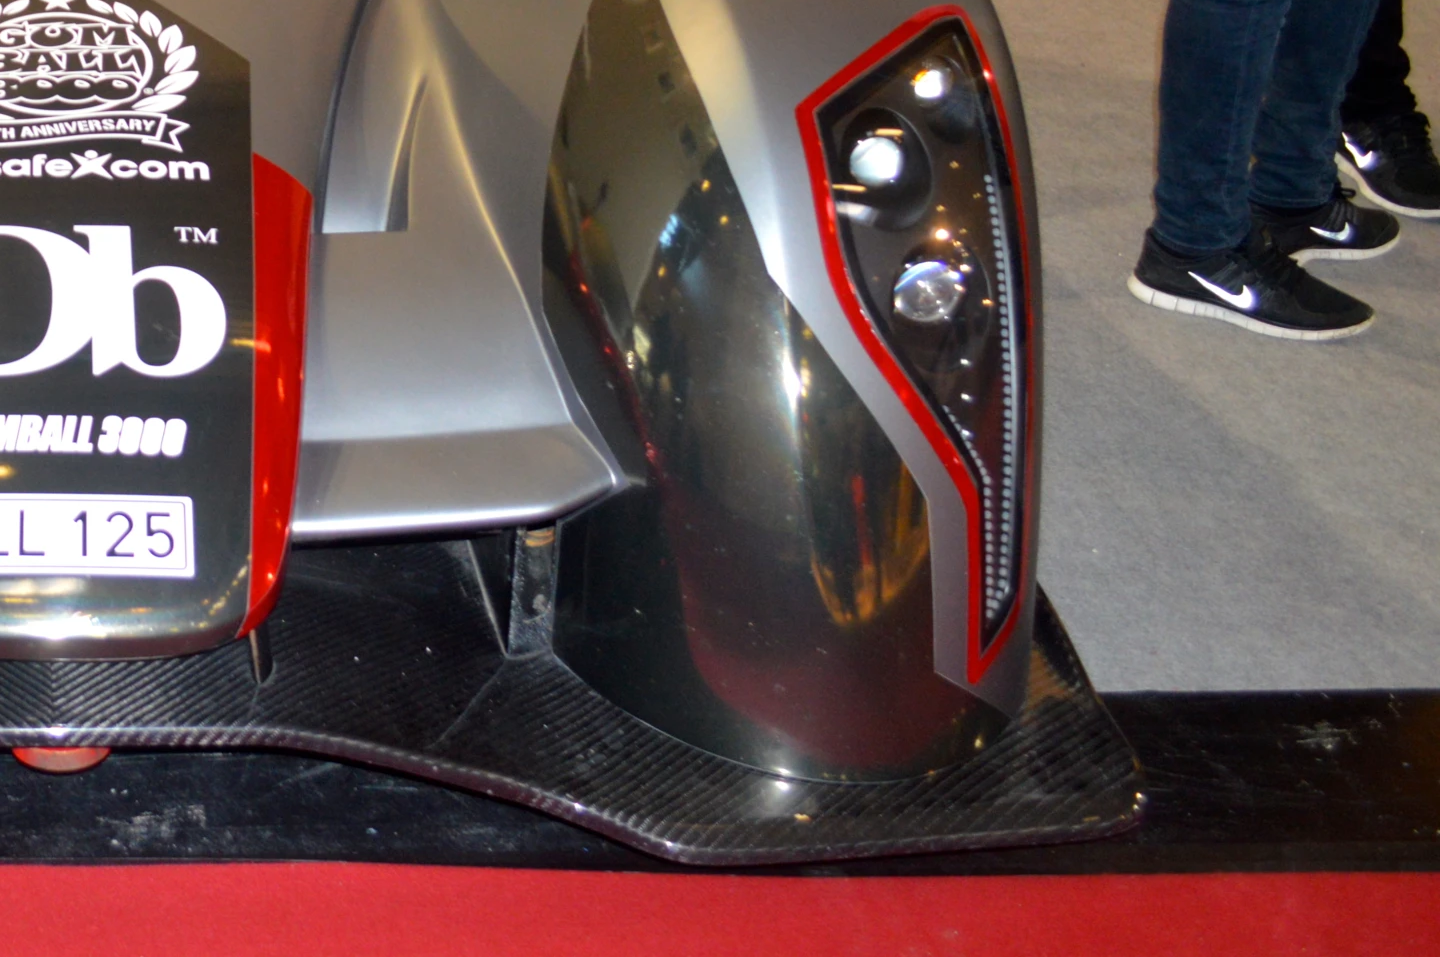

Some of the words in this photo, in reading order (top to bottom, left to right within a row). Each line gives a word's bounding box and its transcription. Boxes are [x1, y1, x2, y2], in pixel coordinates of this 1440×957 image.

[20, 117, 157, 140] ANNIVERSARY
[98, 414, 188, 458] 3000
[73, 509, 175, 558] 125
